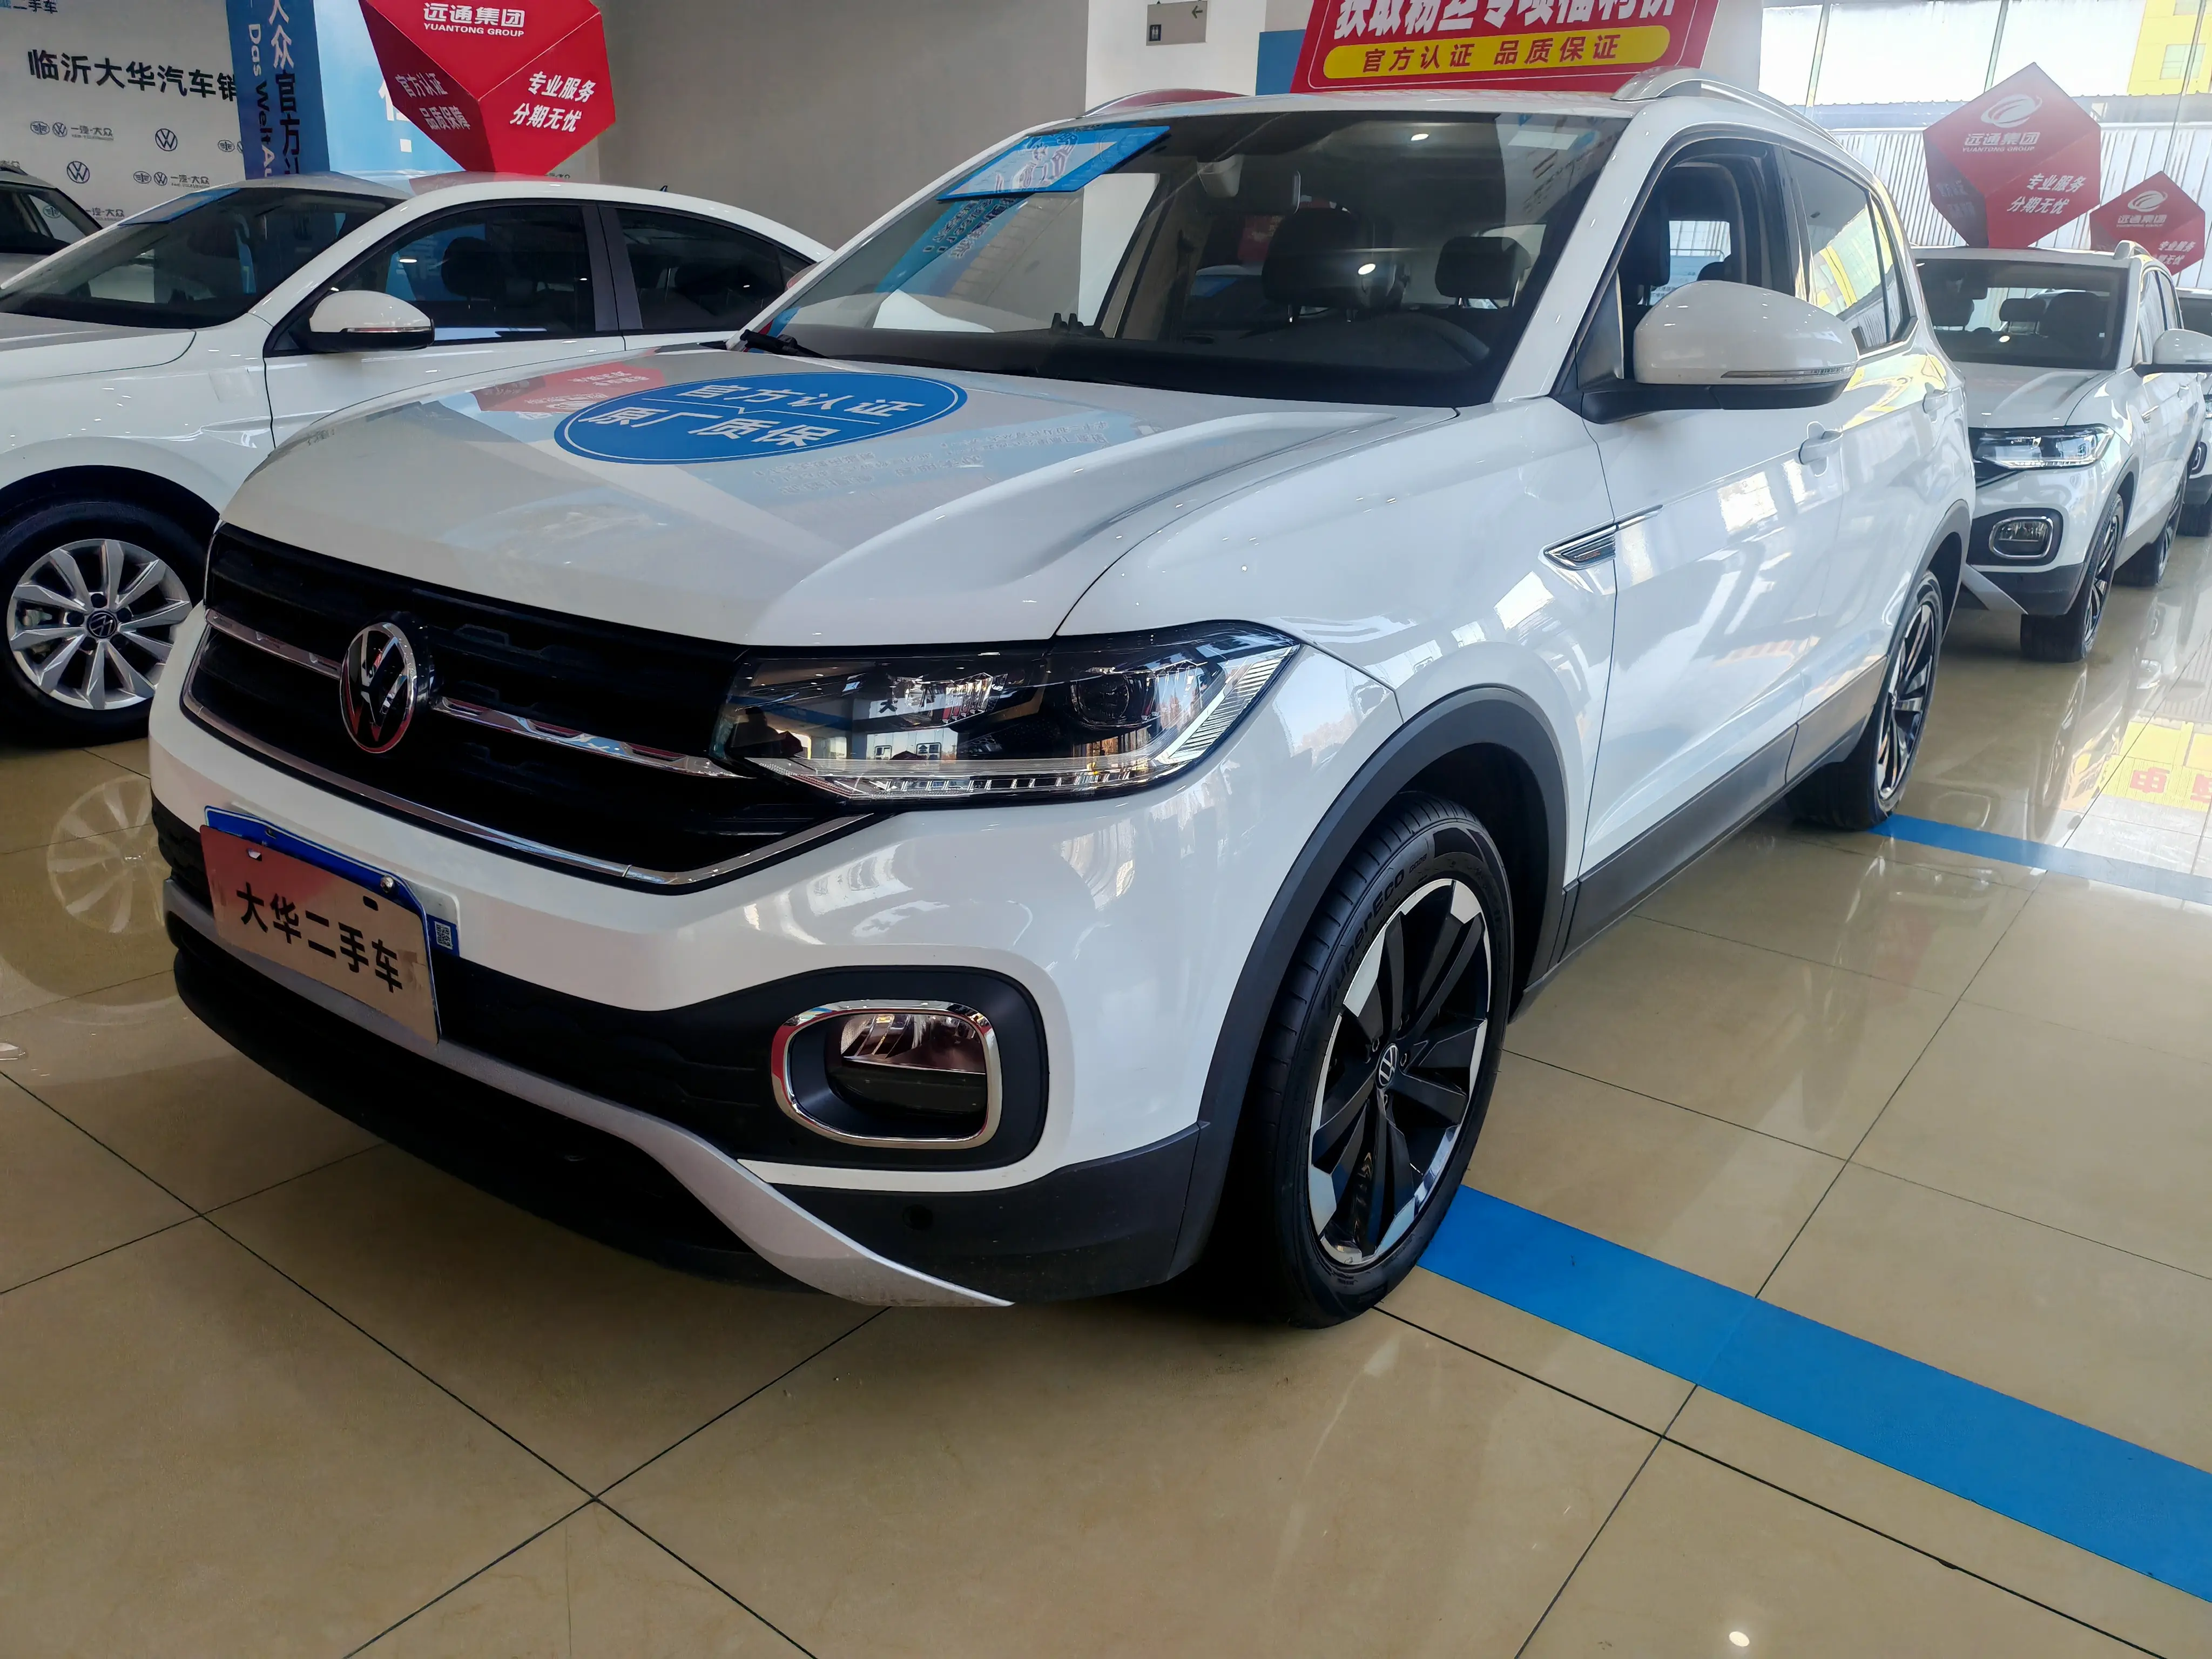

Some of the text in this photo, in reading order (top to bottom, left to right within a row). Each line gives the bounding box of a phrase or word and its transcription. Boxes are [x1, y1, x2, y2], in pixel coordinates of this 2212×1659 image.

[423, 3, 525, 28] 远通集团
[424, 23, 524, 37] YUANTONG GROUP
[248, 24, 261, 76] Das
[1363, 35, 1621, 73] 官方认证 品质保证
[28, 49, 237, 102] 临沂大华汽车销
[395, 72, 448, 98] 官方认证
[528, 71, 596, 103] 专业服务
[419, 105, 470, 130] 品质保障
[510, 103, 582, 132] 分期无忧
[1964, 132, 2040, 145] 远通集团
[2027, 173, 2086, 192] 专业服务
[2007, 196, 2069, 214] 分期无忧
[675, 385, 926, 417] 官方认证
[578, 406, 840, 447] 原厂质保
[237, 881, 403, 993] 大华二手车
